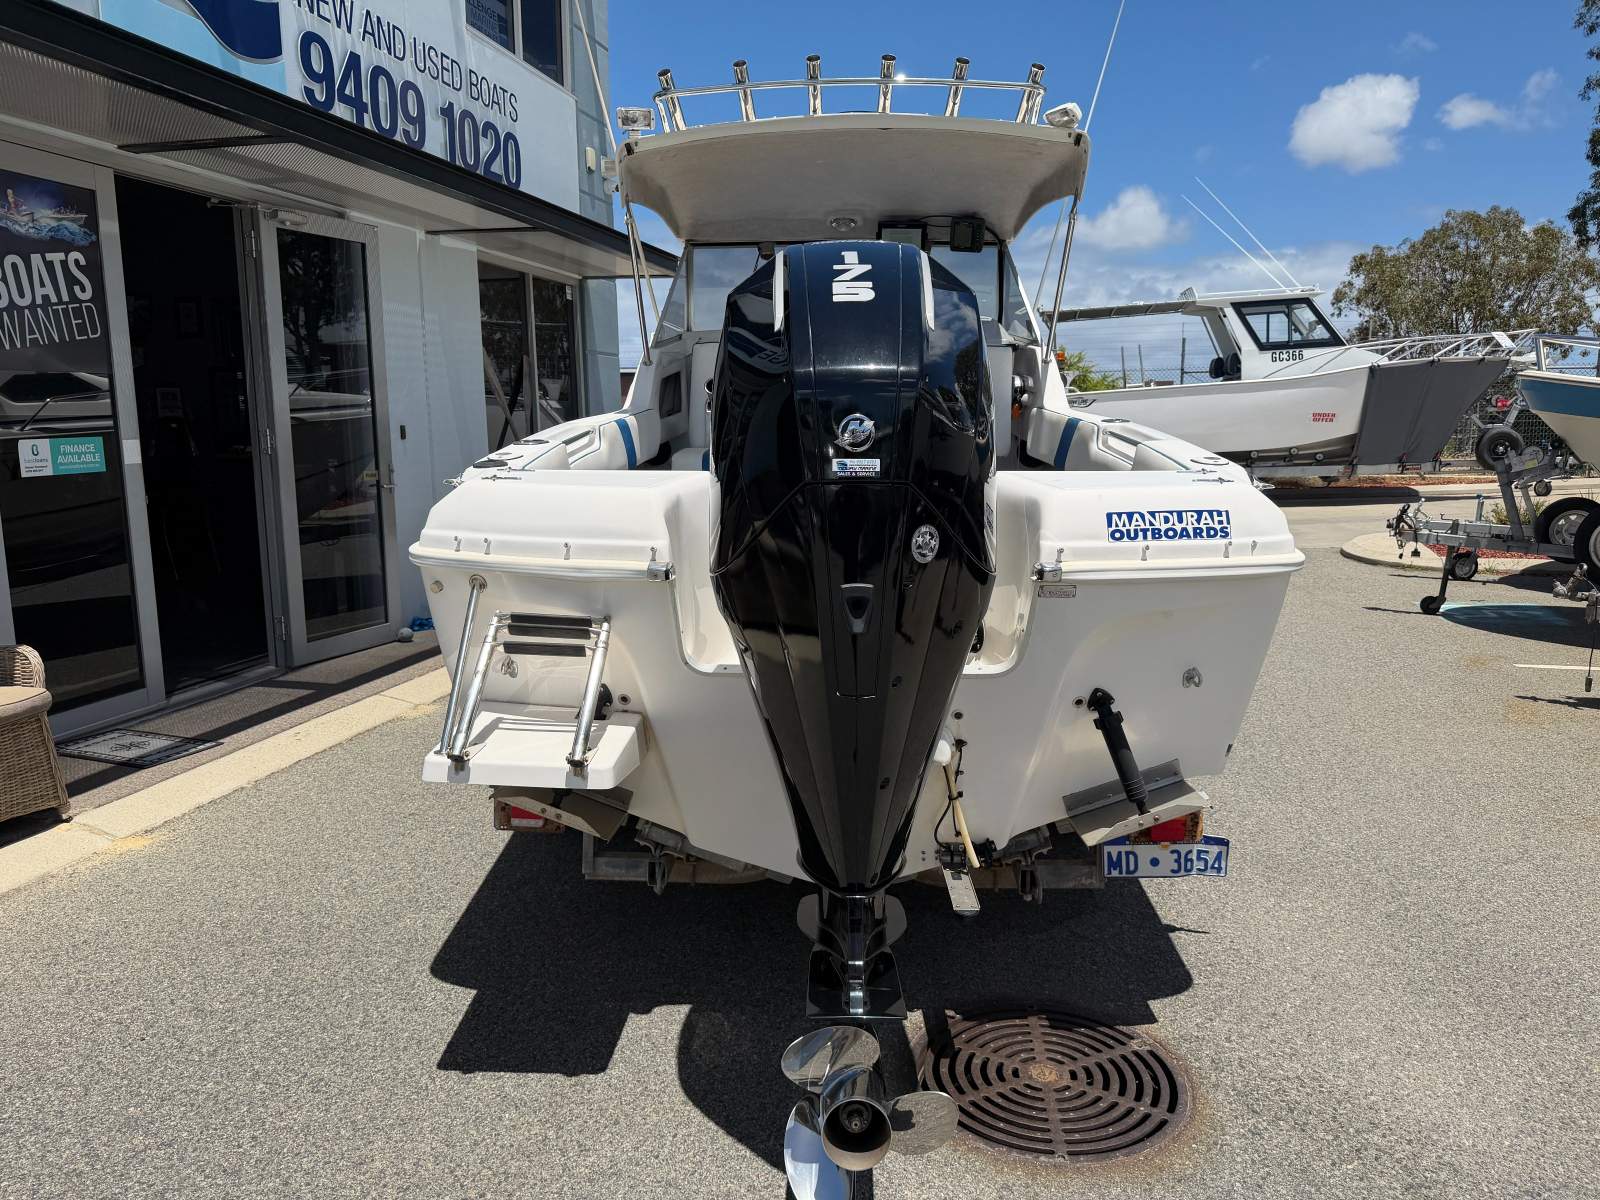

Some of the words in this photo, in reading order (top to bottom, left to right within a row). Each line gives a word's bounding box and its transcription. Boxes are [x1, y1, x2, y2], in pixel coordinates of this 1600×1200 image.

[361, 9, 406, 61] AND
[413, 37, 462, 92] USED
[469, 69, 518, 123] BOATS
[300, 31, 426, 150] 9409
[440, 101, 522, 190] 1020
[0, 303, 101, 350] WANTED
[1271, 349, 1304, 362] GC366
[60, 444, 96, 454] FINANCE
[57, 453, 101, 464] AVAILABLE
[1111, 512, 1228, 528] MANDURAH
[1110, 526, 1230, 541] OUTBOARDS
[1106, 850, 1139, 875] MD
[1170, 848, 1223, 874] 3654
